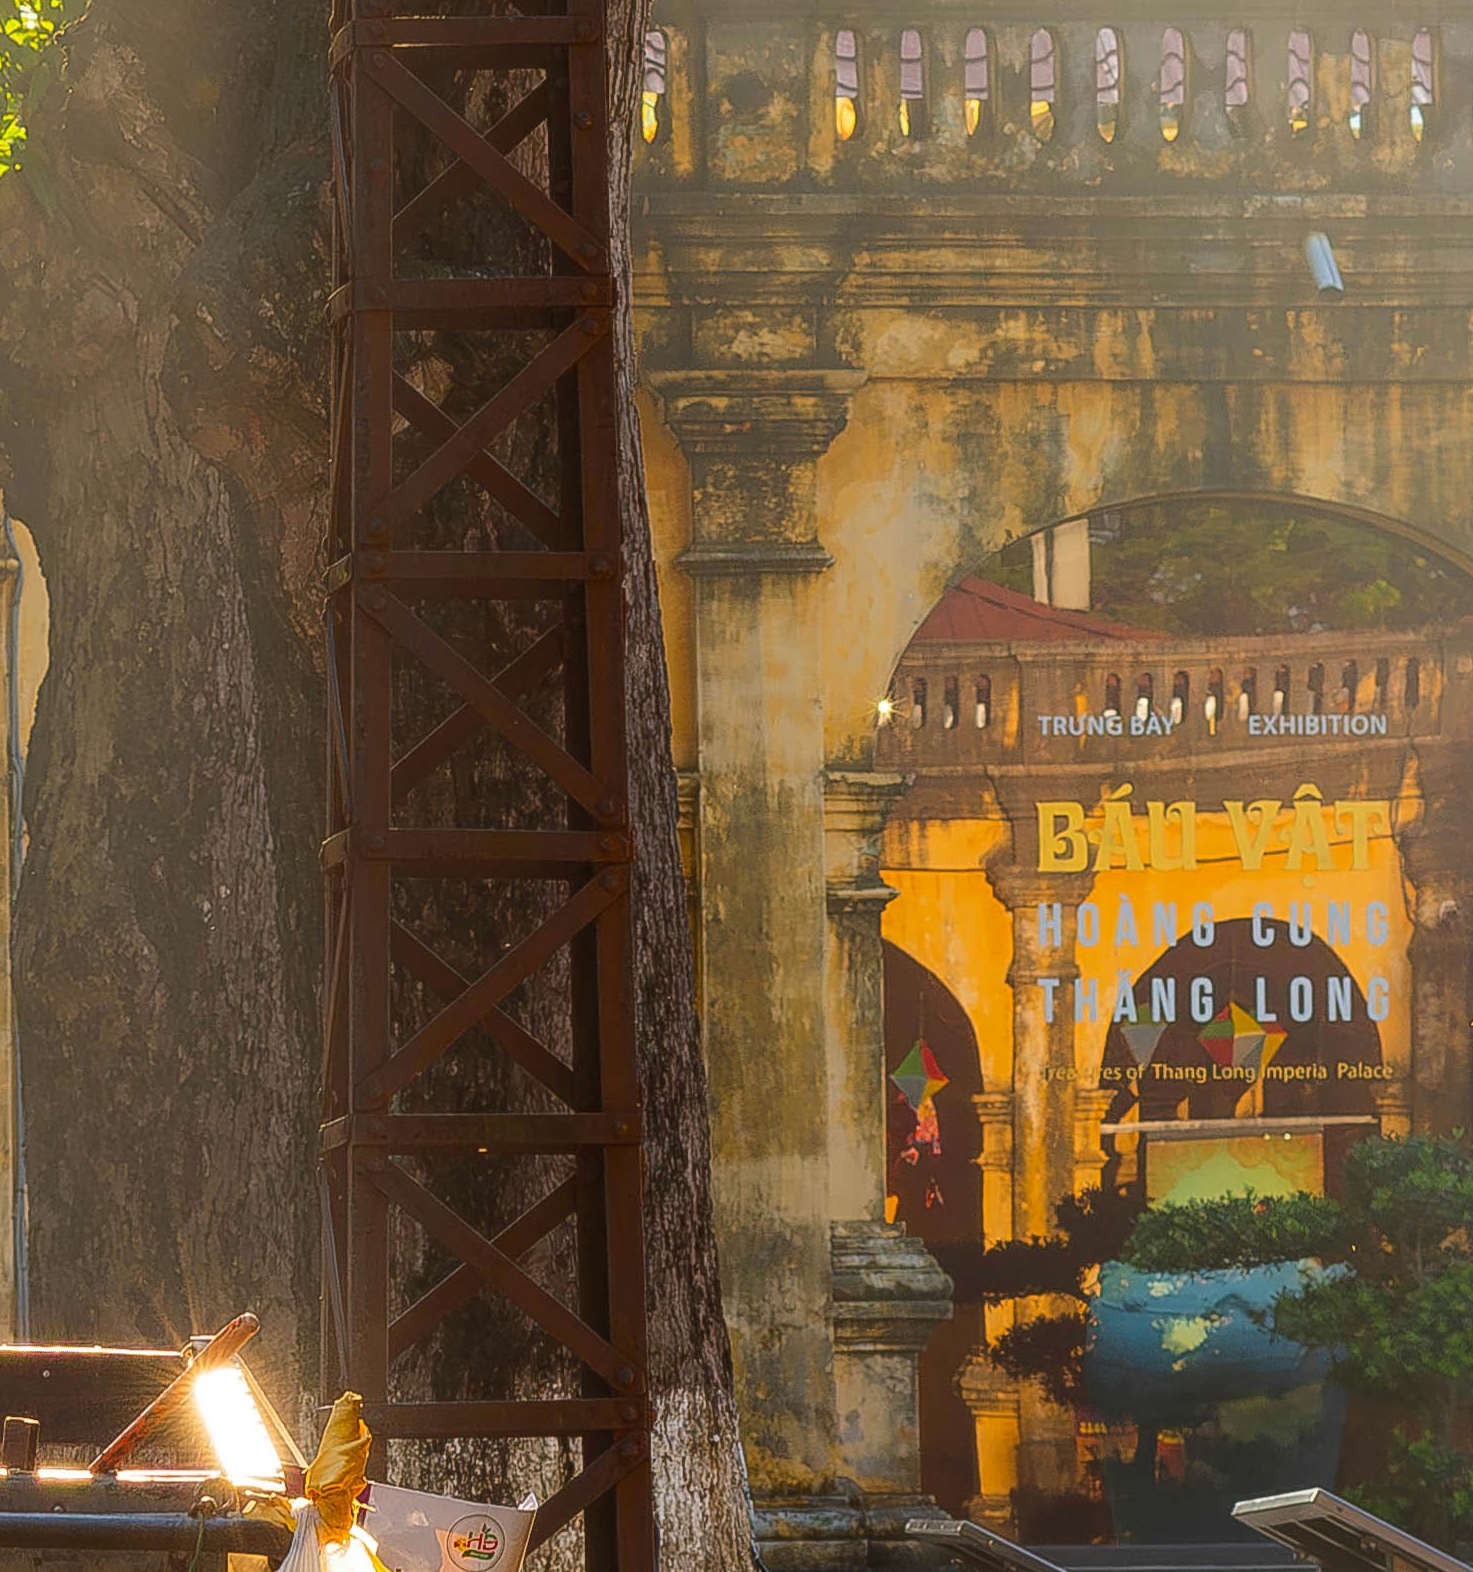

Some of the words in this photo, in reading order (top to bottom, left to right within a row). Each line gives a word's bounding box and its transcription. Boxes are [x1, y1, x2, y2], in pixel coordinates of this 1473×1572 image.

[1037, 713, 1123, 737] TRƯNG
[1130, 711, 1176, 736] BÀY
[1248, 714, 1387, 736] EXHIBITION
[1035, 783, 1198, 872] BÁU
[1222, 783, 1390, 889] VẬT
[1038, 893, 1215, 948] HOÀNG
[1252, 901, 1389, 948] CUNG
[1037, 968, 1214, 1024] THĂNG
[1255, 975, 1390, 1023] LONG
[1126, 1063, 1146, 1080] of
[1152, 1063, 1207, 1084] Thang
[1212, 1063, 1256, 1084] Long
[1337, 1061, 1394, 1080] Palace
